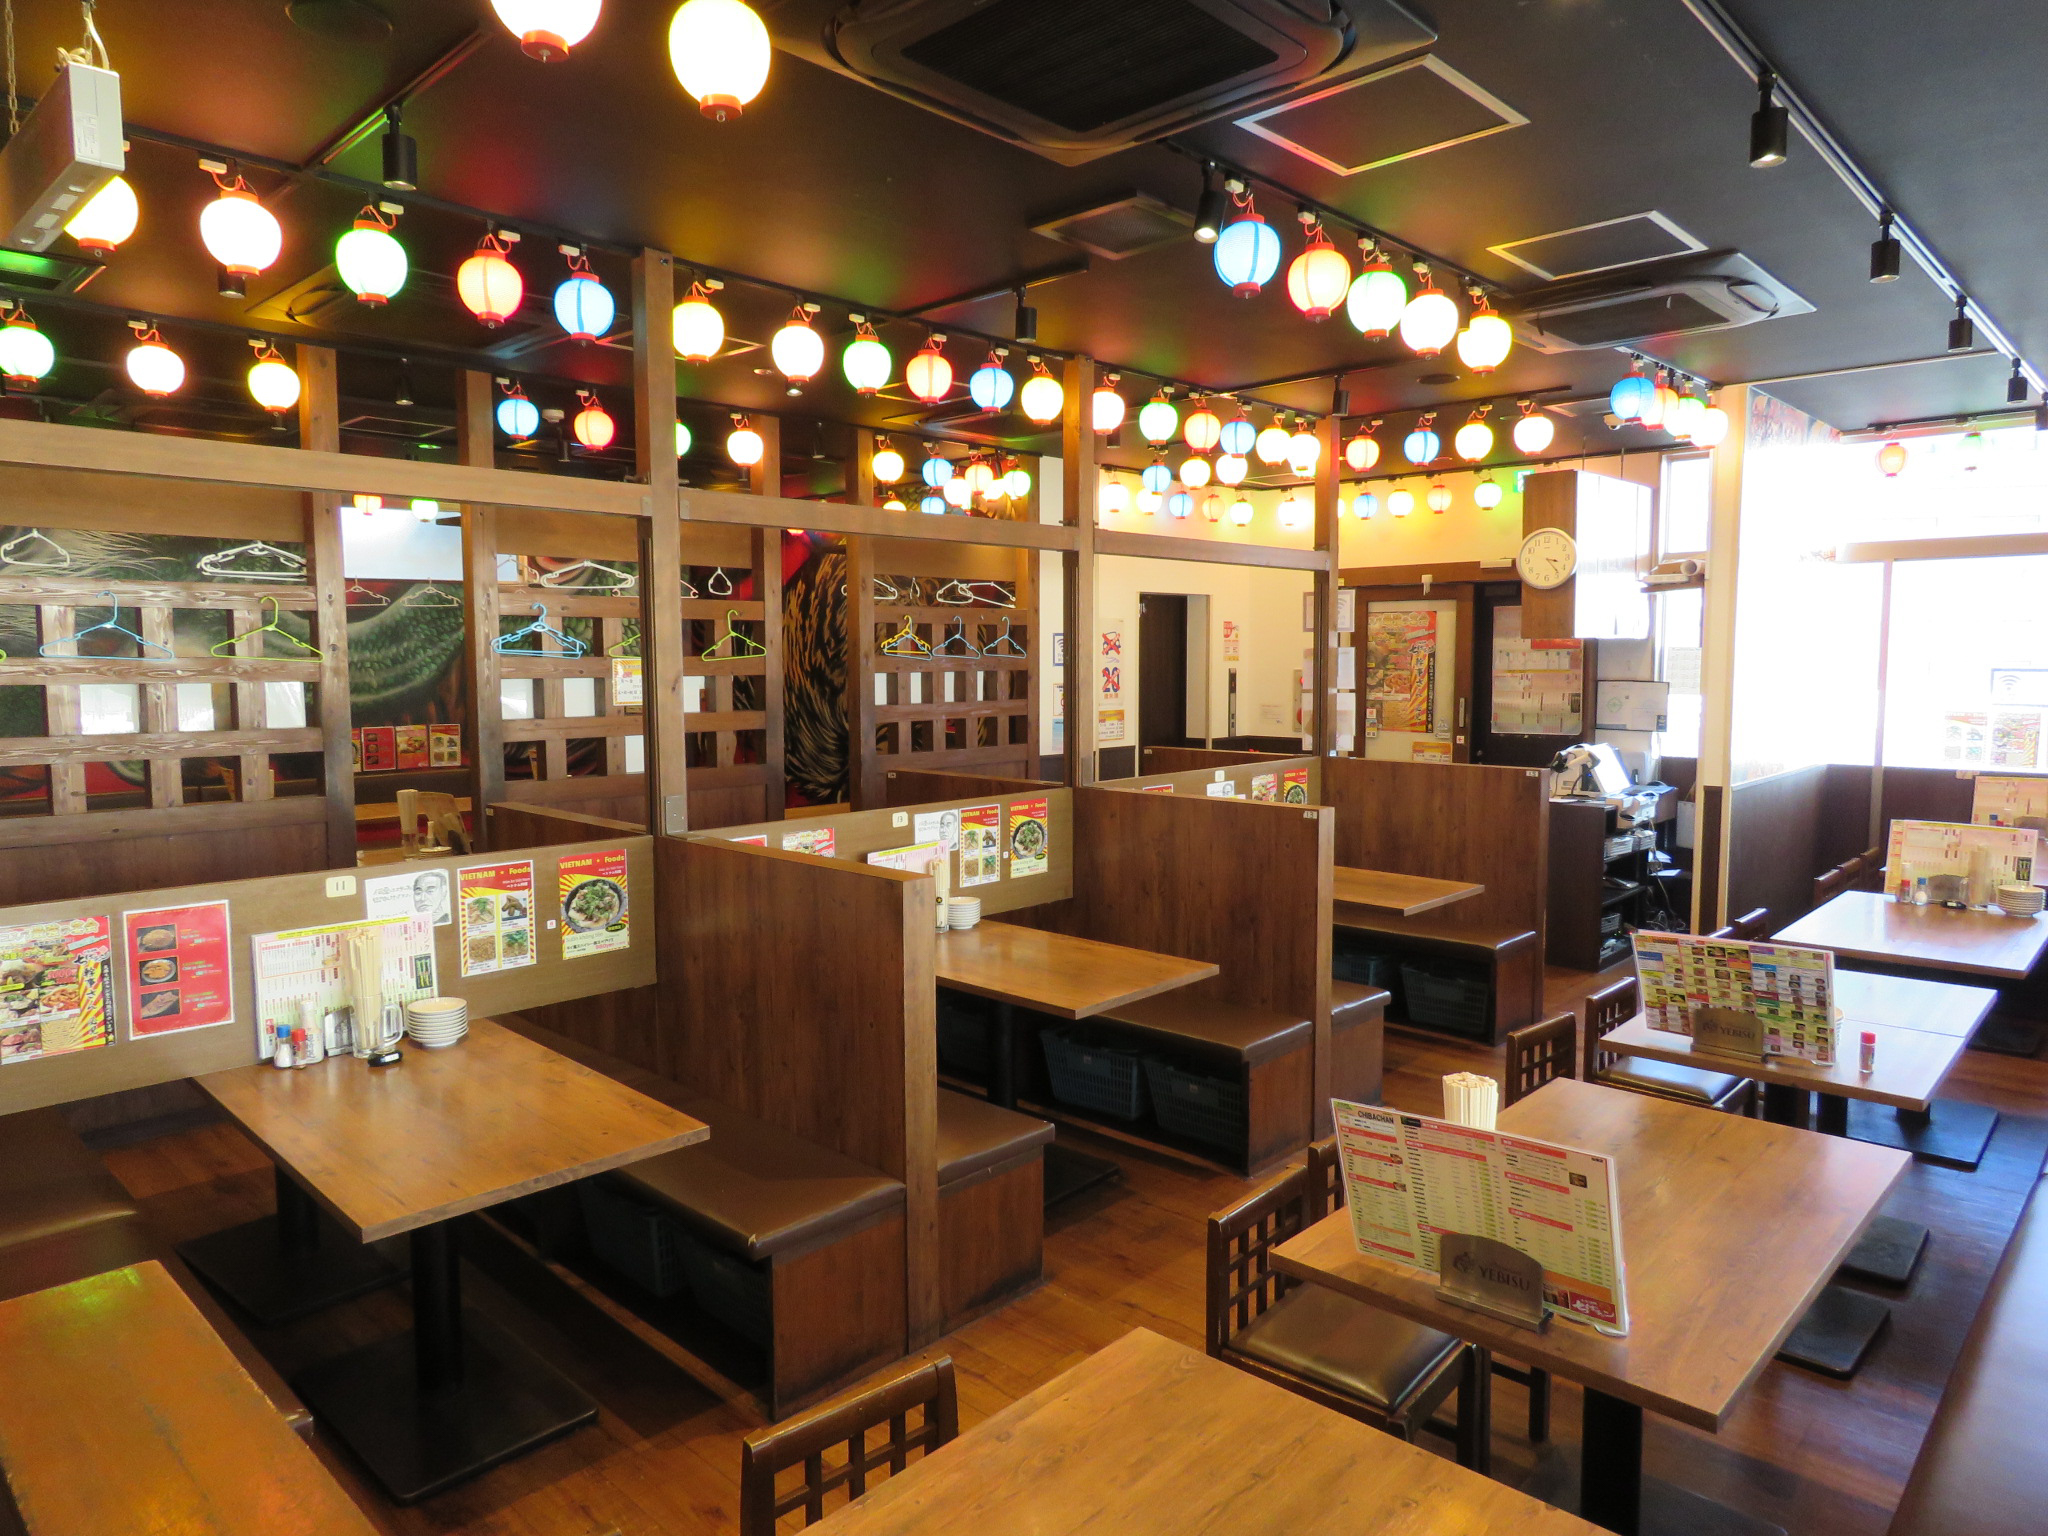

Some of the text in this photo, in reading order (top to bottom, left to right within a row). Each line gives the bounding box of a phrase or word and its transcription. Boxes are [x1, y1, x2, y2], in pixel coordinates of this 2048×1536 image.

[896, 815, 904, 823] 13
[559, 859, 593, 869] VIETNAM
[604, 855, 625, 863] Foods
[459, 870, 496, 881] VIETNAM
[509, 866, 531, 875] Foods
[1720, 1025, 1755, 1039] YEBISU
[1357, 1110, 1394, 1124] CHIBACHAN
[1478, 1264, 1530, 1291] YEBISU
